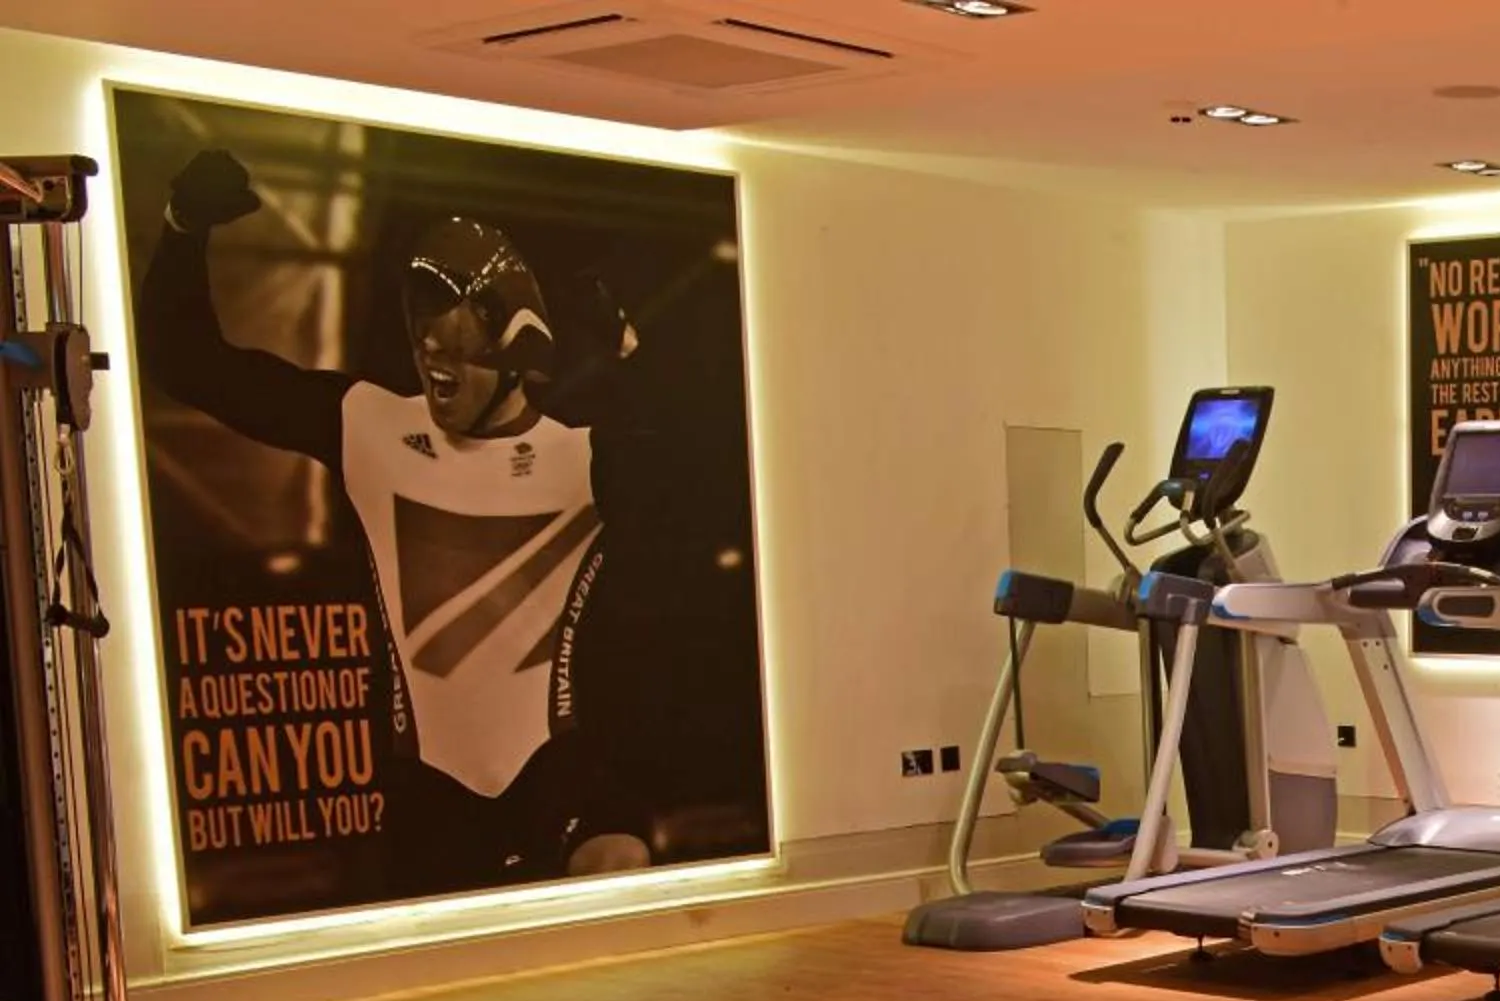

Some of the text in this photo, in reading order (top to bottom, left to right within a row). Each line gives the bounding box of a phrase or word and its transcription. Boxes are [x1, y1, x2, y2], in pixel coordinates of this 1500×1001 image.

[1418, 257, 1463, 298] "NO
[1431, 383, 1457, 404] THE
[1462, 381, 1499, 403] REST
[176, 604, 370, 665] IT'S NEVER
[556, 553, 603, 717] GREAT BRITAIN
[180, 677, 198, 719] A
[201, 669, 337, 719] QUESTION
[339, 667, 370, 709] OF
[183, 718, 373, 800] CAN YOU
[188, 792, 385, 851] BUT WILL YOU?
